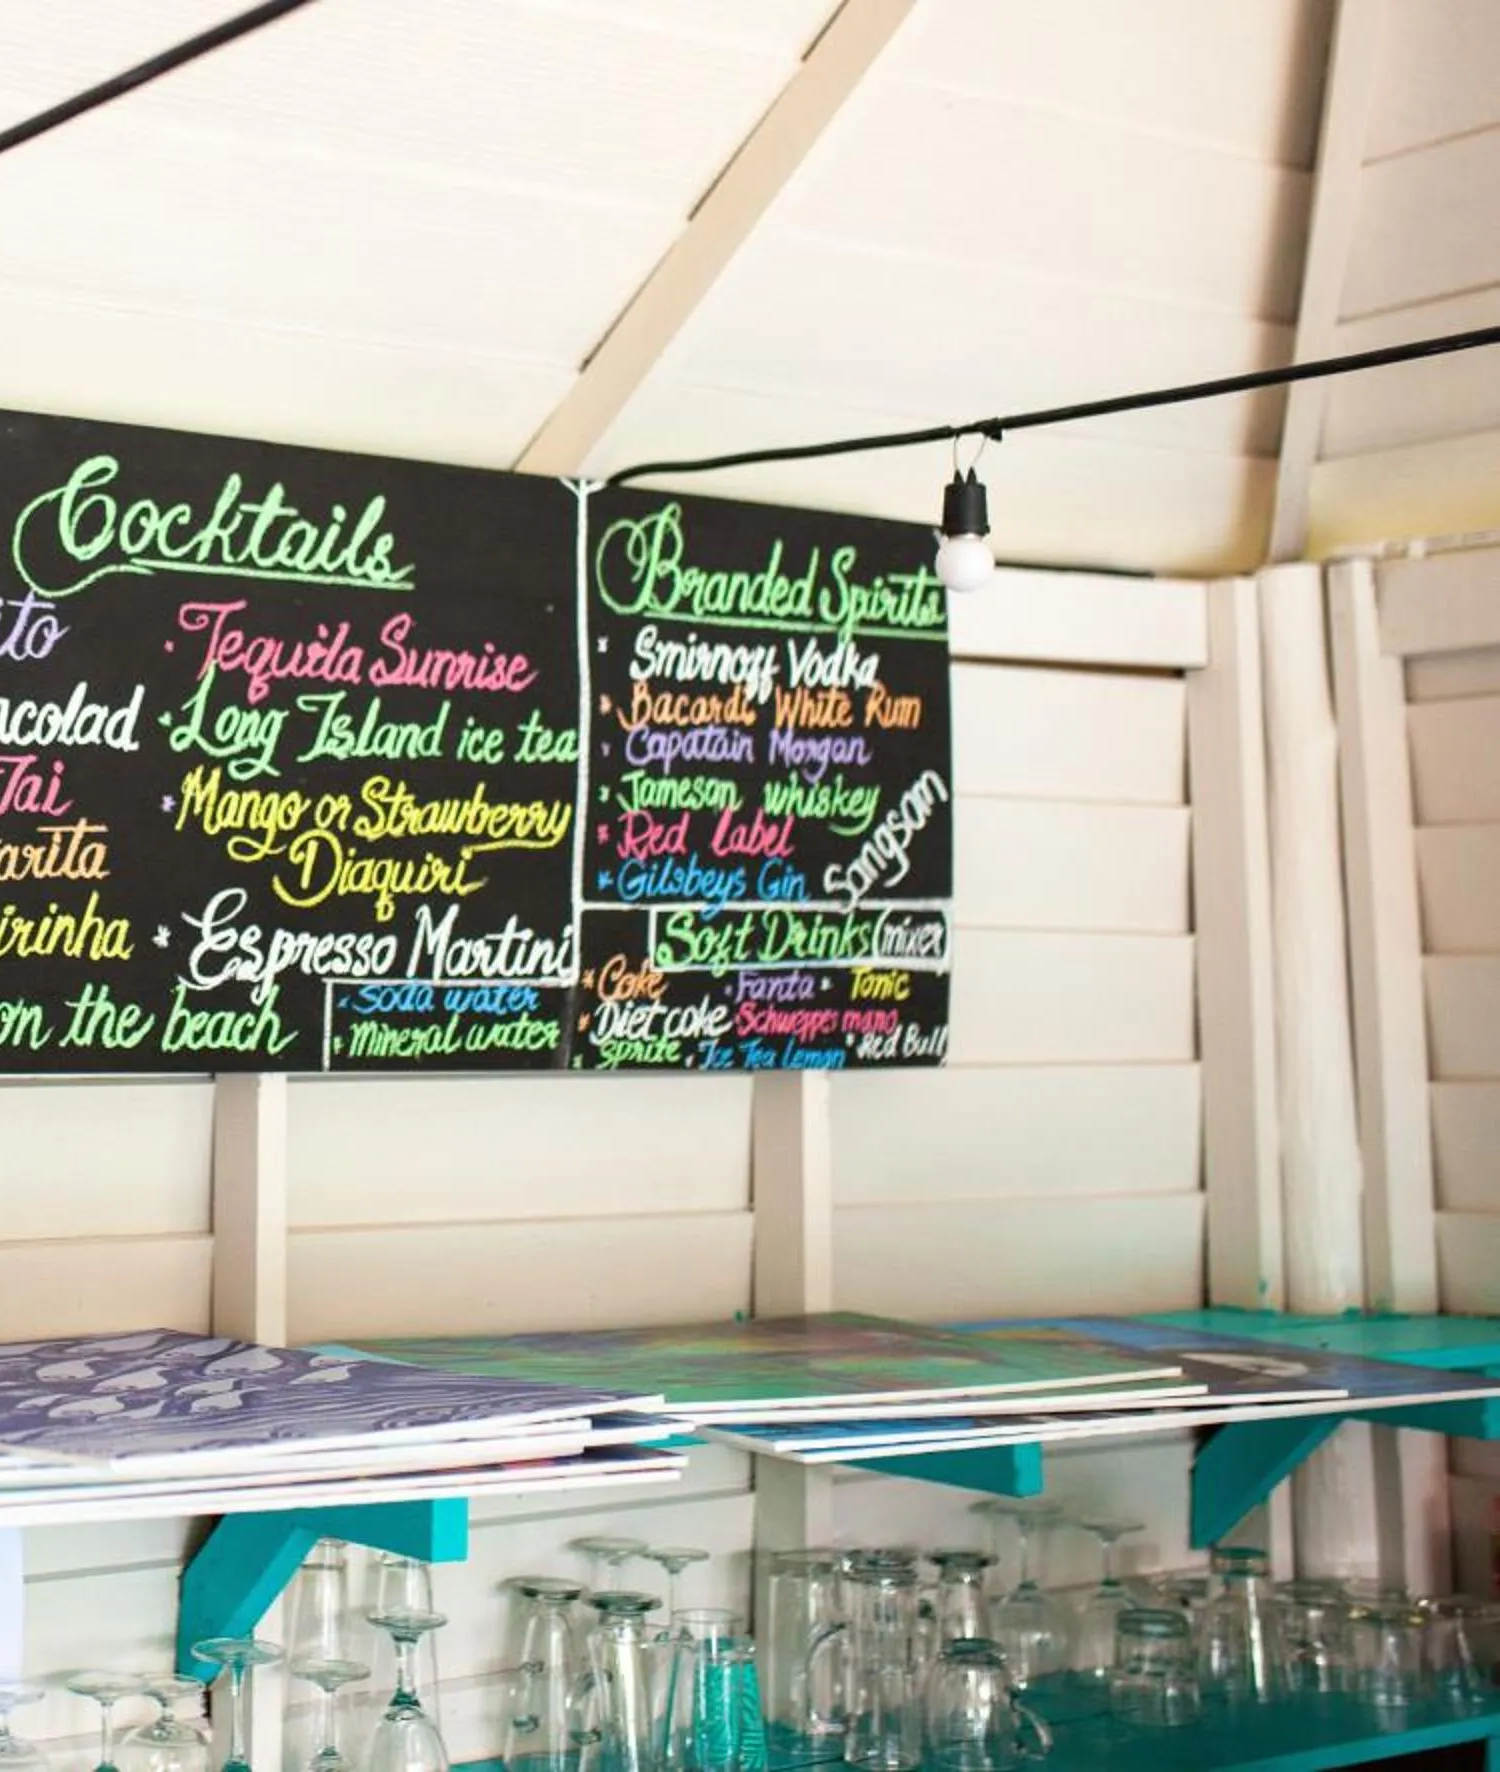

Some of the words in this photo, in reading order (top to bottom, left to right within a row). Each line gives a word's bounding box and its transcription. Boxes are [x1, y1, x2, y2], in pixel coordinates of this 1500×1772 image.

[12, 455, 415, 597] Cocktails
[597, 503, 819, 616] Branded
[821, 546, 947, 643] Spirits
[179, 600, 364, 703] Tequila
[369, 612, 539, 692] Sunrise
[629, 626, 779, 702] Smirnoff
[788, 637, 879, 689] Vodka
[169, 659, 289, 780] Long
[296, 690, 450, 762] Island
[456, 716, 504, 764] ice
[515, 708, 580, 763] tea
[616, 680, 756, 732] Bacardi
[775, 684, 853, 729] White
[864, 680, 921, 728] Rum
[769, 728, 873, 782] Morgan
[175, 765, 311, 862] Mango
[315, 794, 351, 830] or
[355, 775, 571, 852] Strawberry
[616, 769, 743, 812] Jameson
[616, 809, 691, 860] Red
[273, 829, 489, 922] Diaquiri
[757, 857, 811, 901] Gin
[178, 887, 397, 1001] Espresso
[407, 903, 576, 978] Martini
[656, 911, 755, 978] Soft
[757, 909, 871, 961] Drinks
[443, 983, 540, 1014] water
[598, 953, 669, 1001] Coke
[735, 969, 815, 1004] Fanta
[851, 966, 911, 1001] Tonic
[59, 983, 155, 1048] the
[162, 983, 298, 1055] beach
[465, 1012, 561, 1050] water
[589, 998, 668, 1046] Diet
